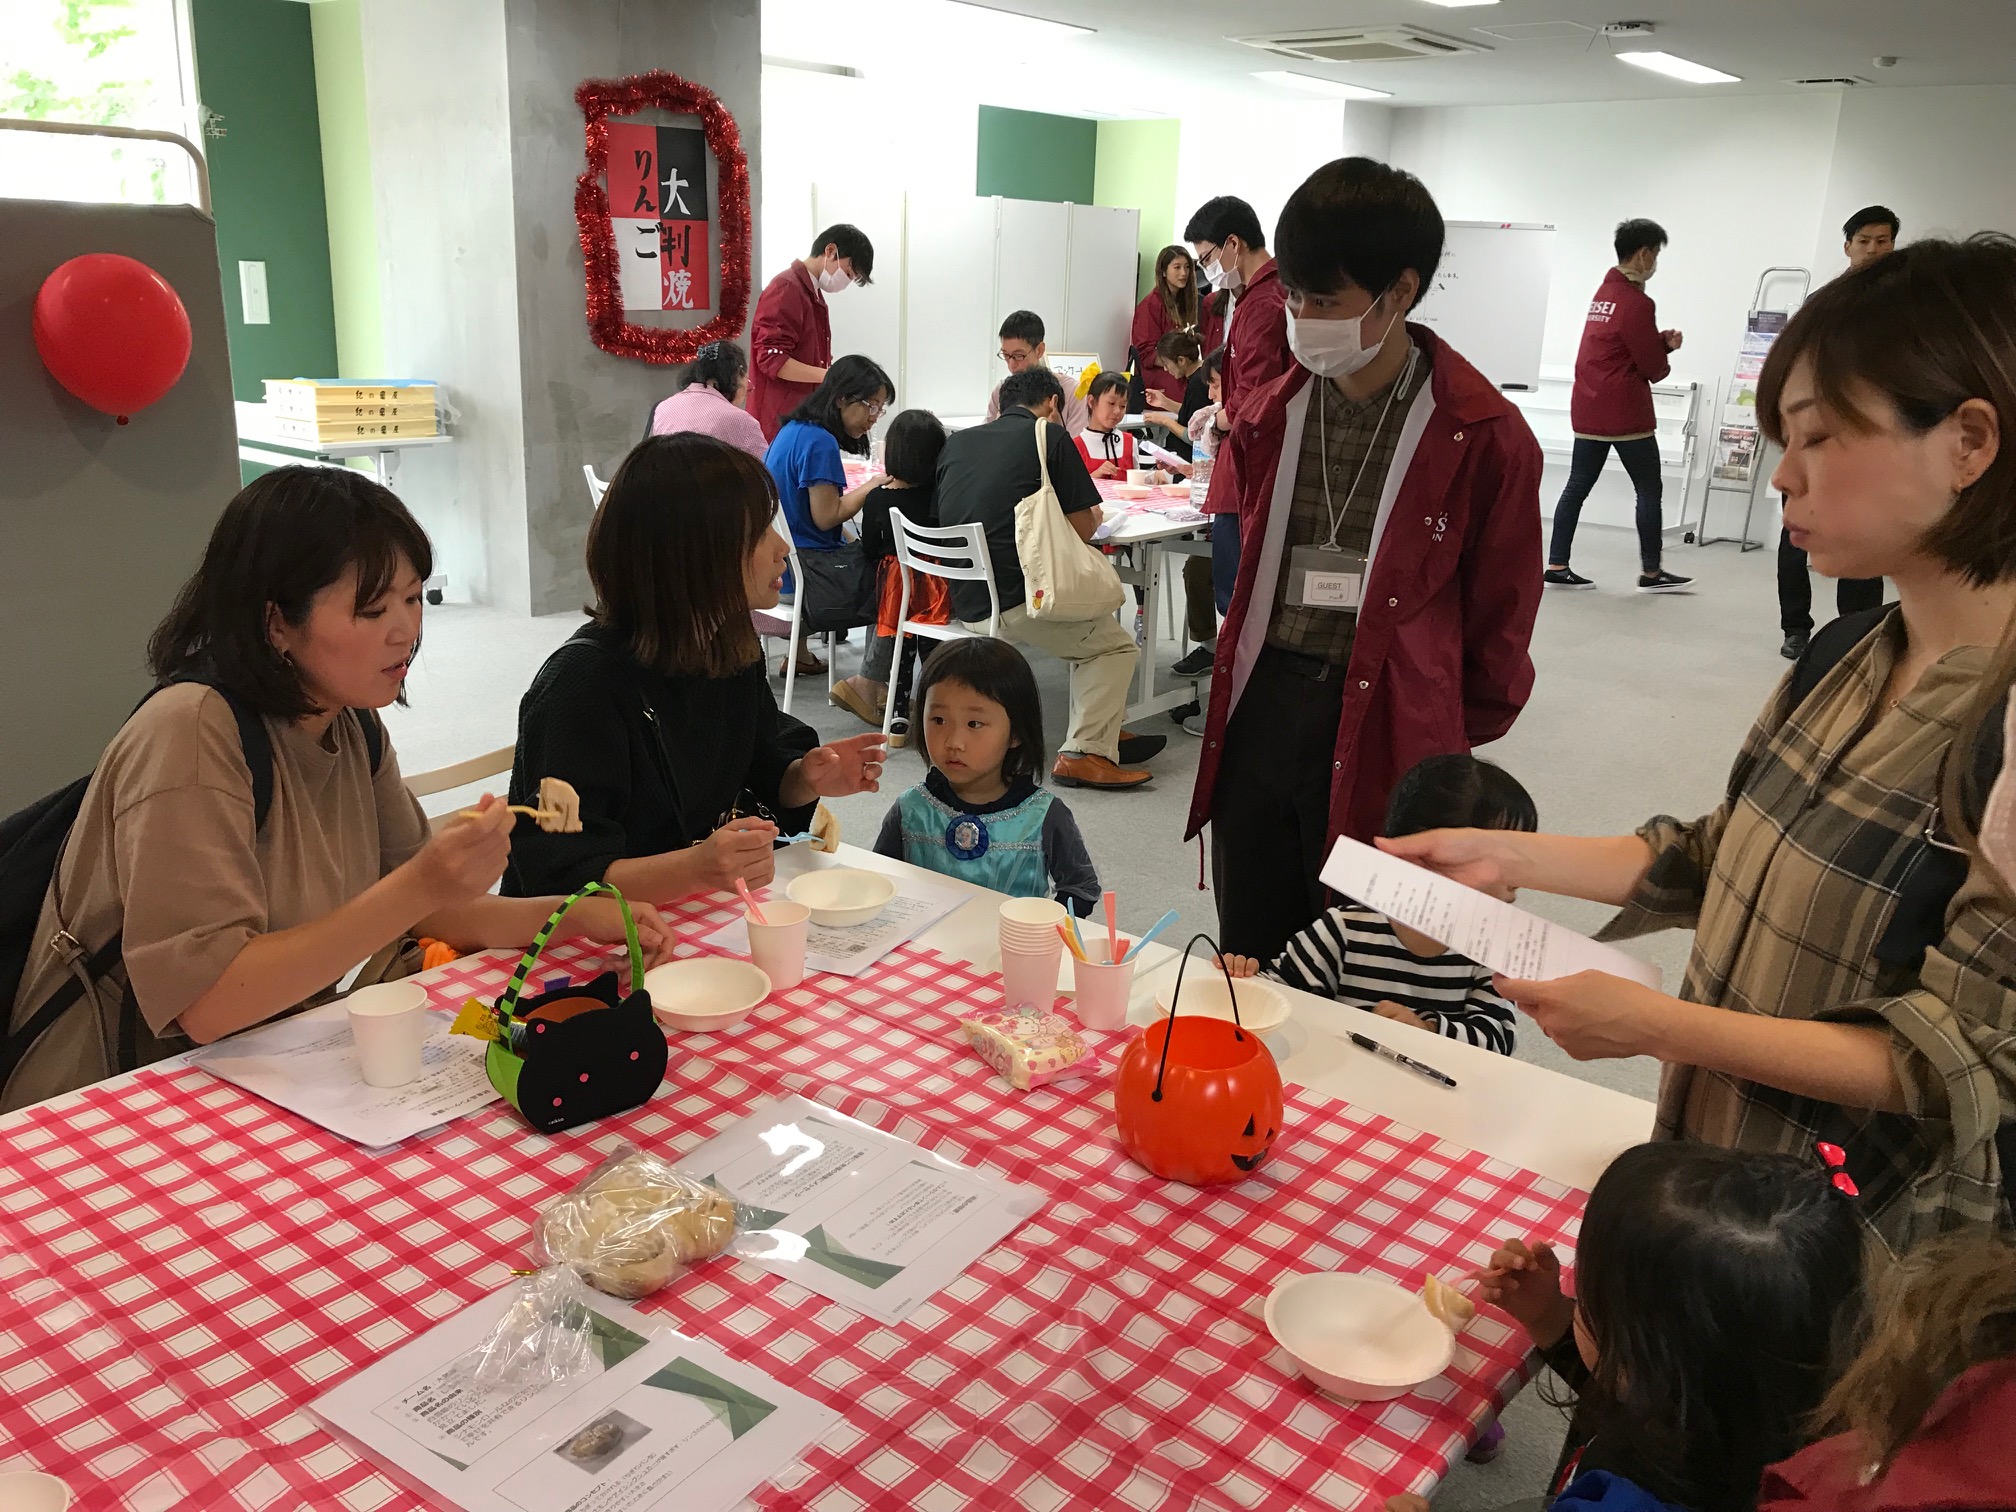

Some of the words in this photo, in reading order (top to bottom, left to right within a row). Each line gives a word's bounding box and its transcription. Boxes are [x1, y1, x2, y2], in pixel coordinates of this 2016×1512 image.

[633, 148, 665, 259] りんご
[660, 167, 695, 309] 大判焼
[1317, 581, 1342, 590] GUEST
